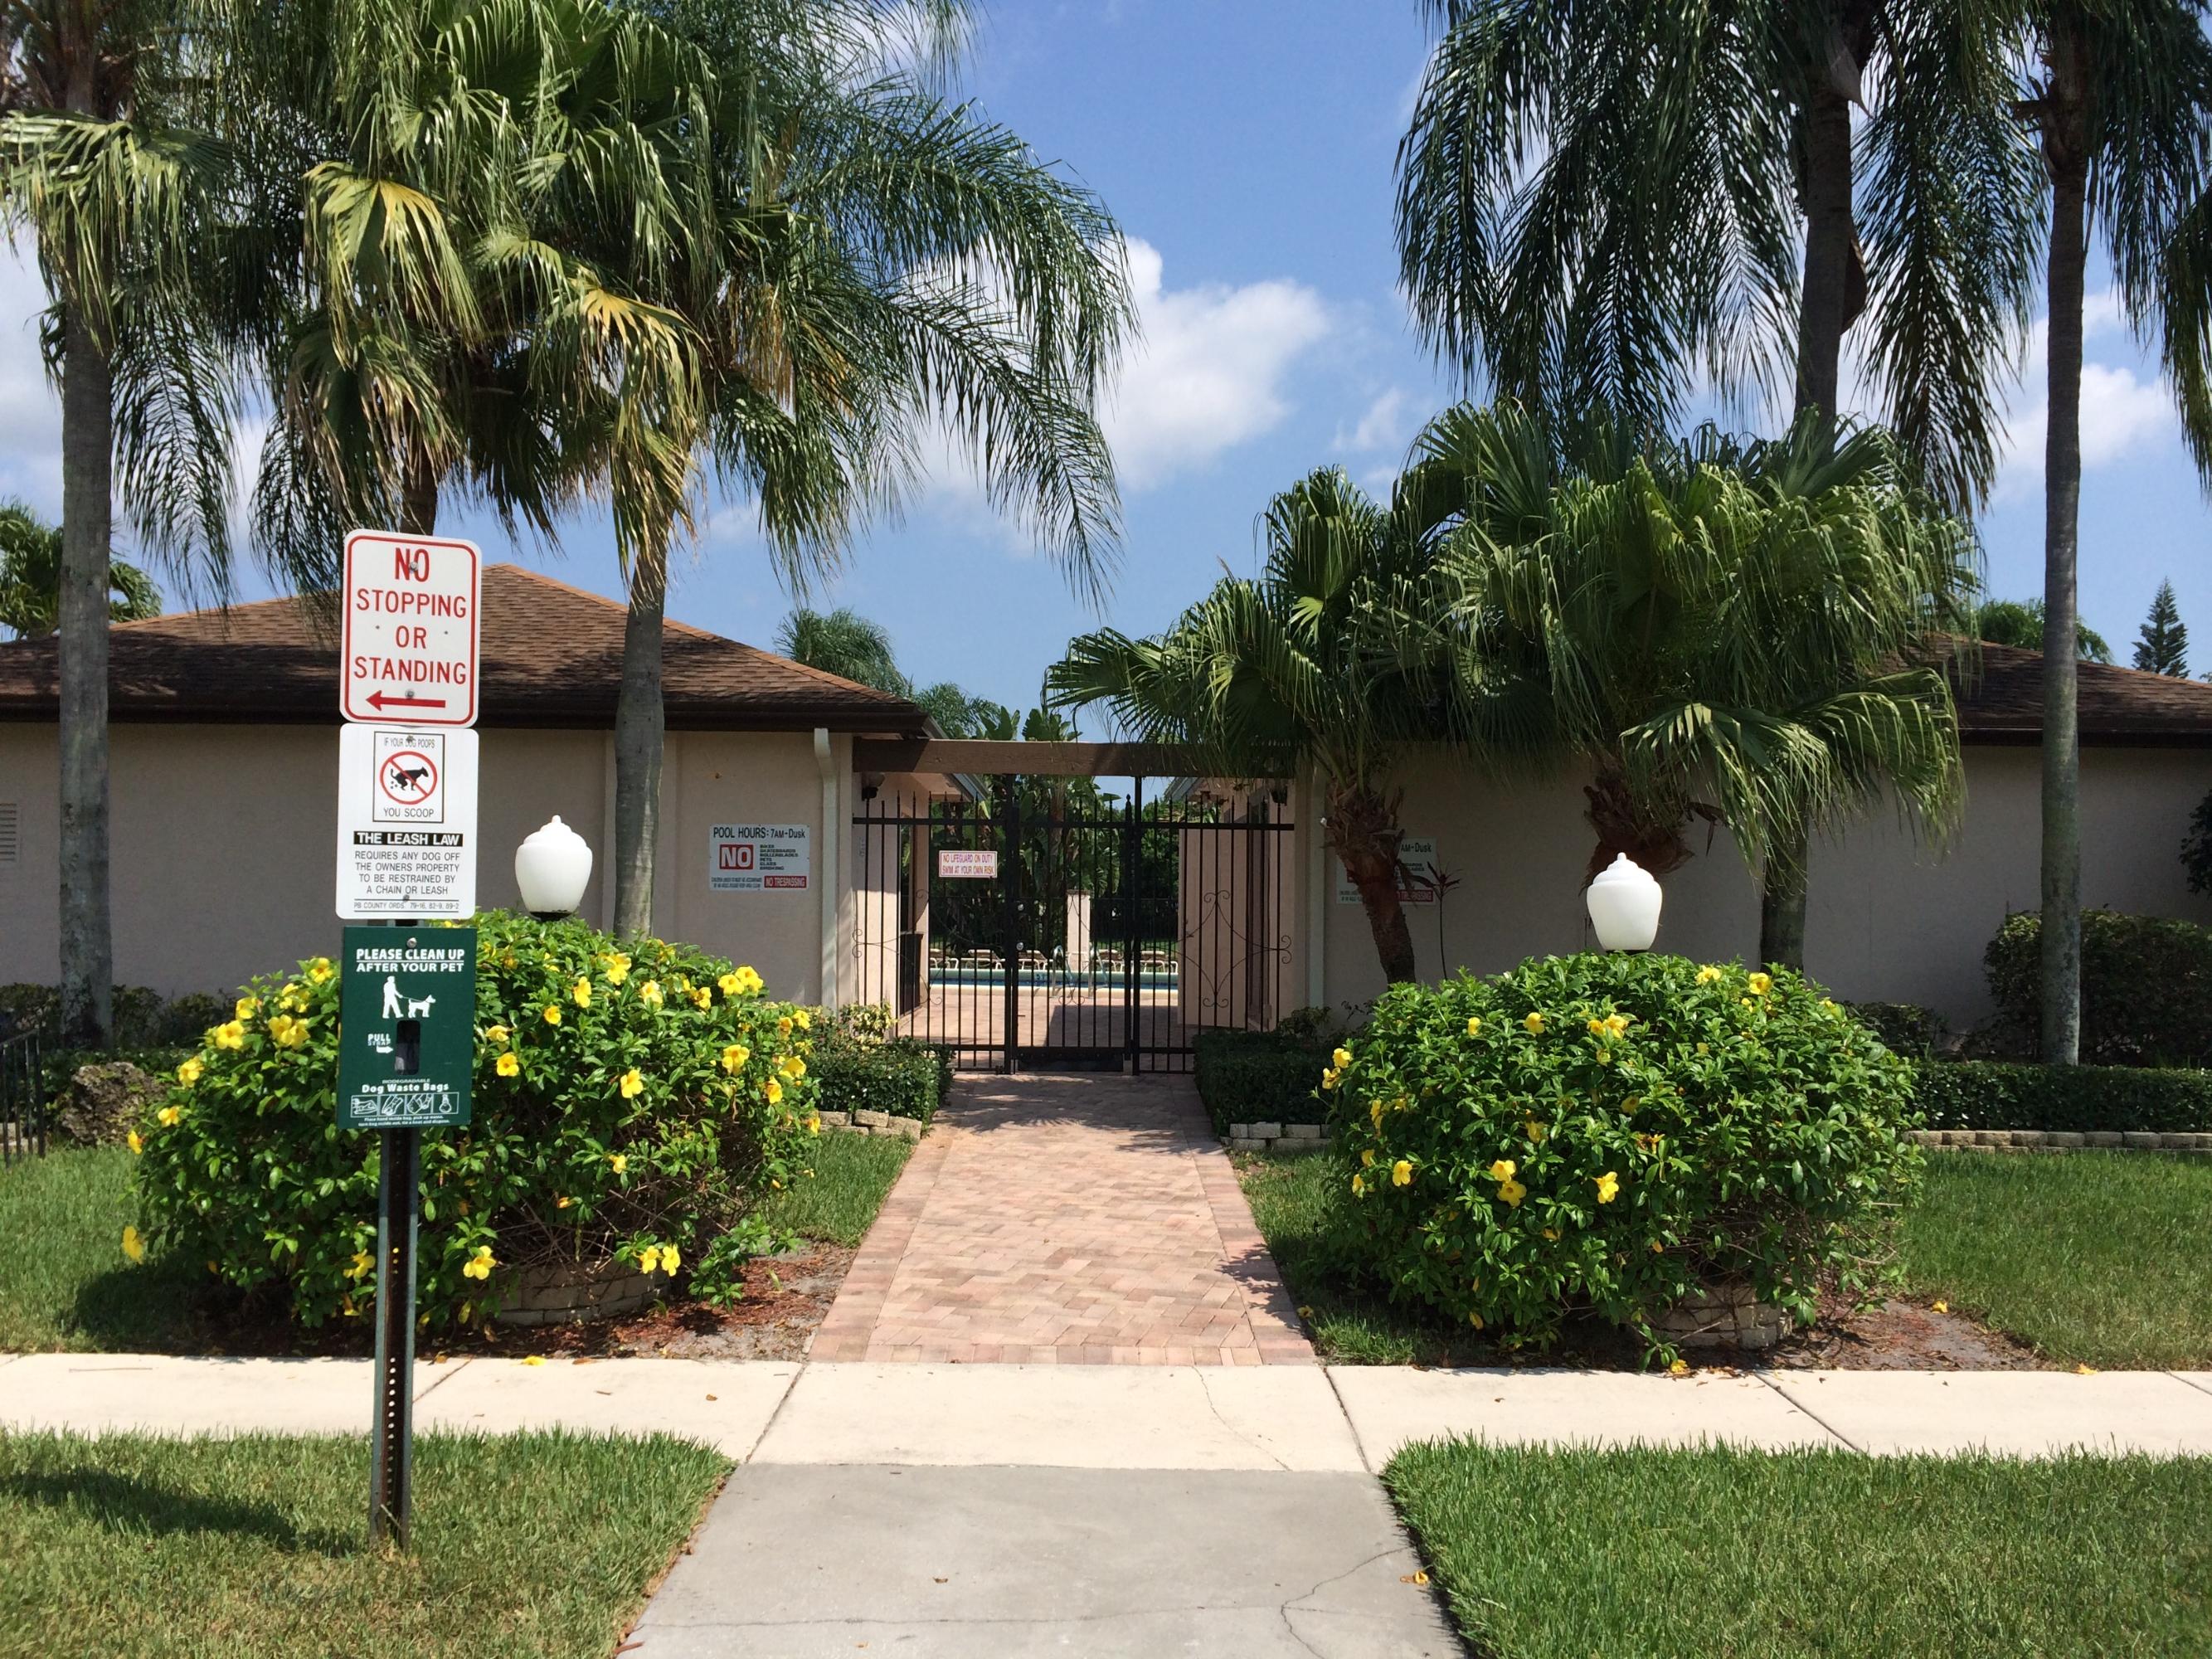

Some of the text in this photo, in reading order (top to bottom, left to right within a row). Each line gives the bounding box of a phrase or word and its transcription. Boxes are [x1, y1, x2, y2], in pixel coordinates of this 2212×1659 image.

[395, 547, 430, 581] NO
[357, 588, 466, 618] STOPPING
[396, 625, 426, 649] OR
[354, 656, 466, 684] STANDING
[384, 737, 389, 746] IF
[391, 737, 403, 747] YOUR
[418, 738, 435, 748] POOPS
[384, 808, 434, 818] YOU SCOOP
[713, 827, 806, 838] POOL HOURS: 7AM-Dusk
[357, 832, 459, 845] THE LEASH LAW
[355, 851, 398, 859] REQUIRES
[401, 852, 418, 860] ANY
[721, 847, 751, 868] NO
[943, 854, 993, 863] NO LIFEGUARD ON DUTY
[355, 863, 459, 872] THE OWNERS PROPERTY
[942, 865, 953, 873] SWIM
[984, 866, 994, 874] RISK
[359, 873, 370, 882] TO
[389, 874, 441, 883] RESTRAINED
[445, 875, 455, 883] BY
[766, 878, 773, 887] NO
[376, 886, 401, 894] CHAIN
[405, 886, 417, 894] OR
[421, 886, 448, 894] LEASH
[356, 949, 464, 960] PLEASE CLEAN UP
[356, 963, 464, 972] AFTER YOUR PET
[367, 1034, 391, 1042] PULL
[362, 1082, 449, 1094] Dog Waste Bags
